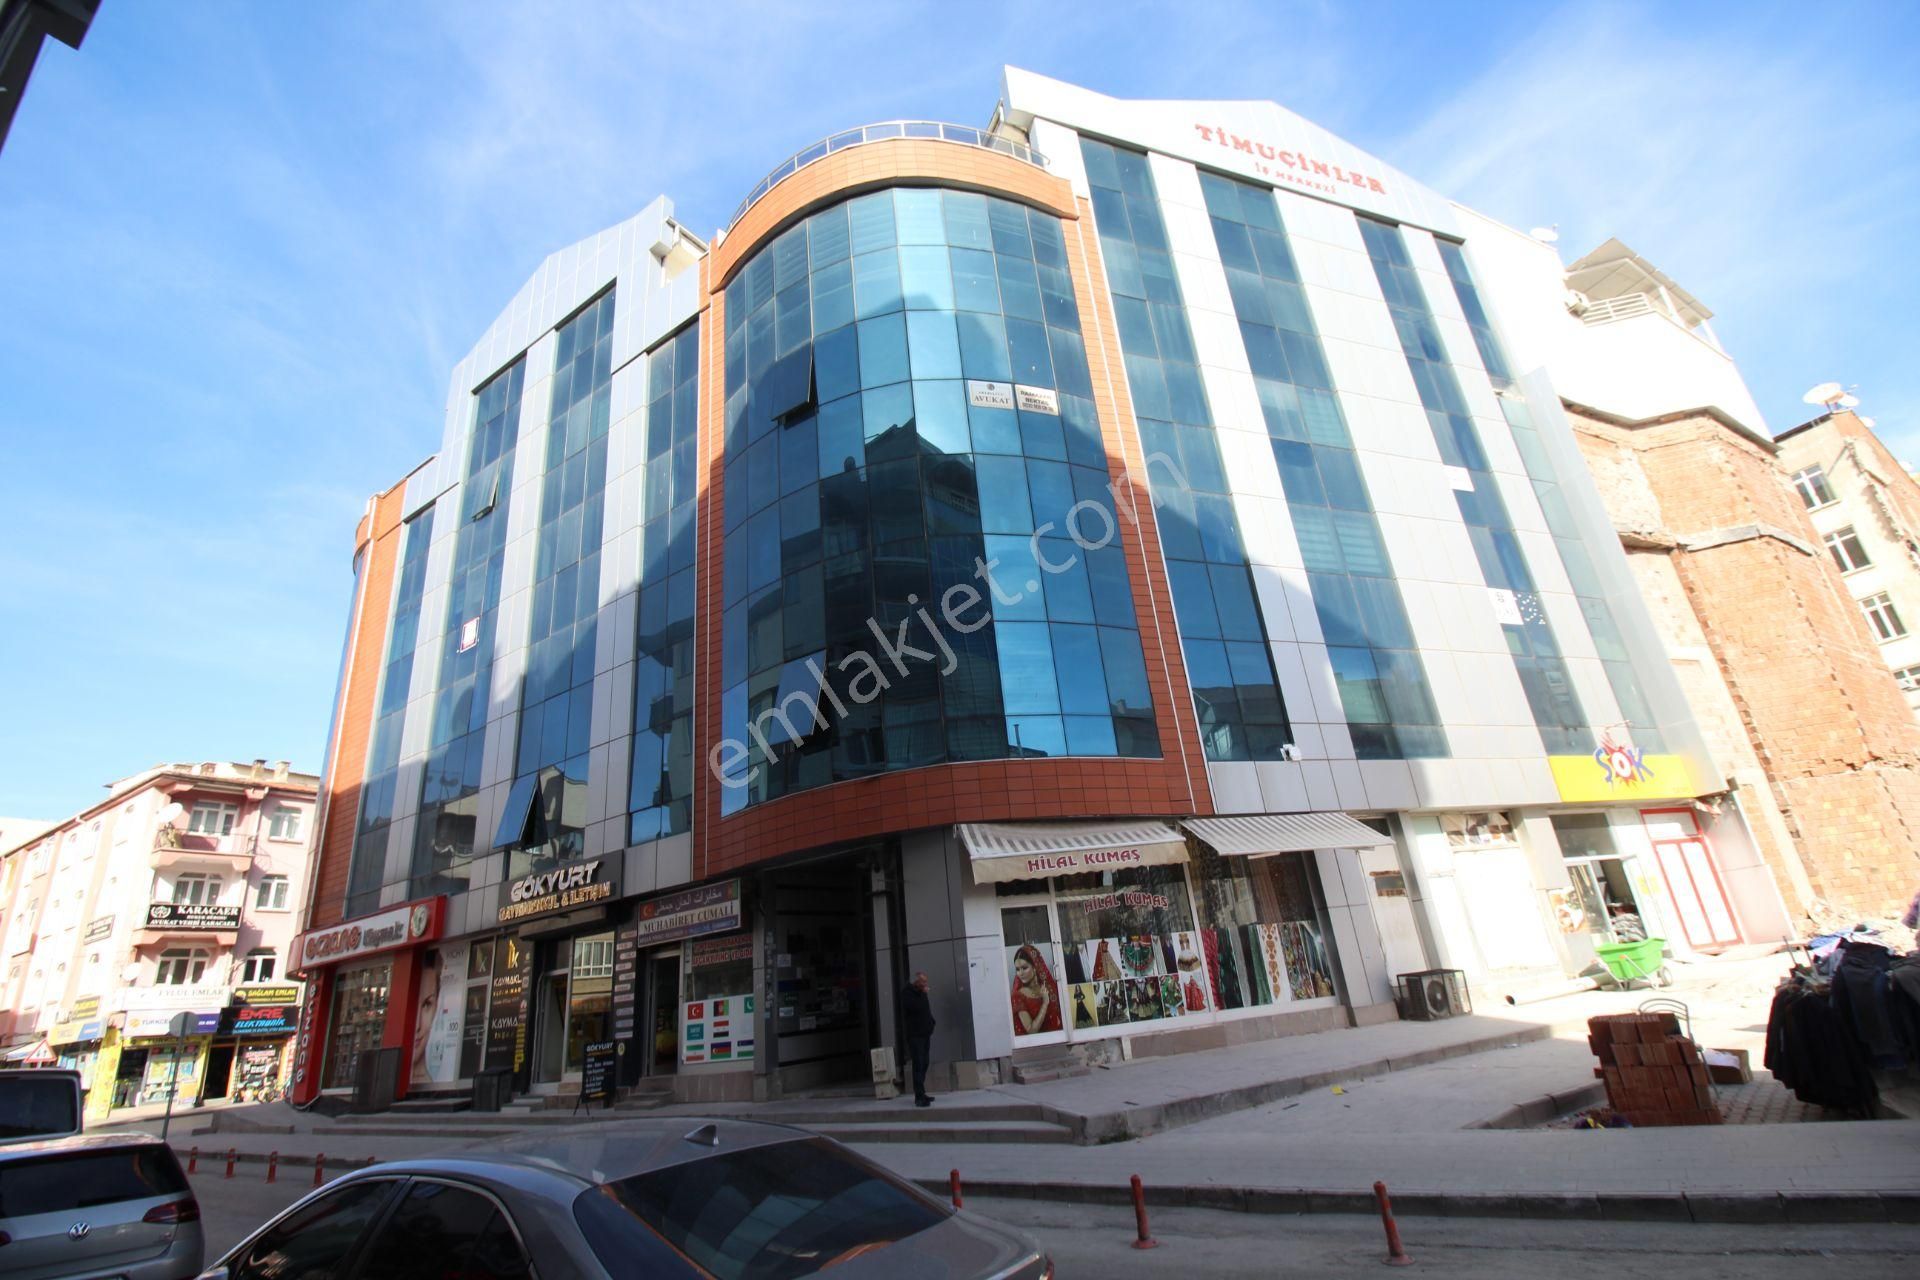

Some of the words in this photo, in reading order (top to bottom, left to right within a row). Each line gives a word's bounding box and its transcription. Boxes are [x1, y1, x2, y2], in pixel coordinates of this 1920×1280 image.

[1194, 123, 1387, 195] TİMUÇİNLER
[1027, 855, 1078, 872] HİLAL
[1084, 849, 1141, 865] KUMAŞ
[511, 861, 599, 902] GÖKYURT
[177, 905, 239, 916] KARACAER
[1084, 894, 1121, 914] HİLAL
[238, 1008, 284, 1020] EMRE
